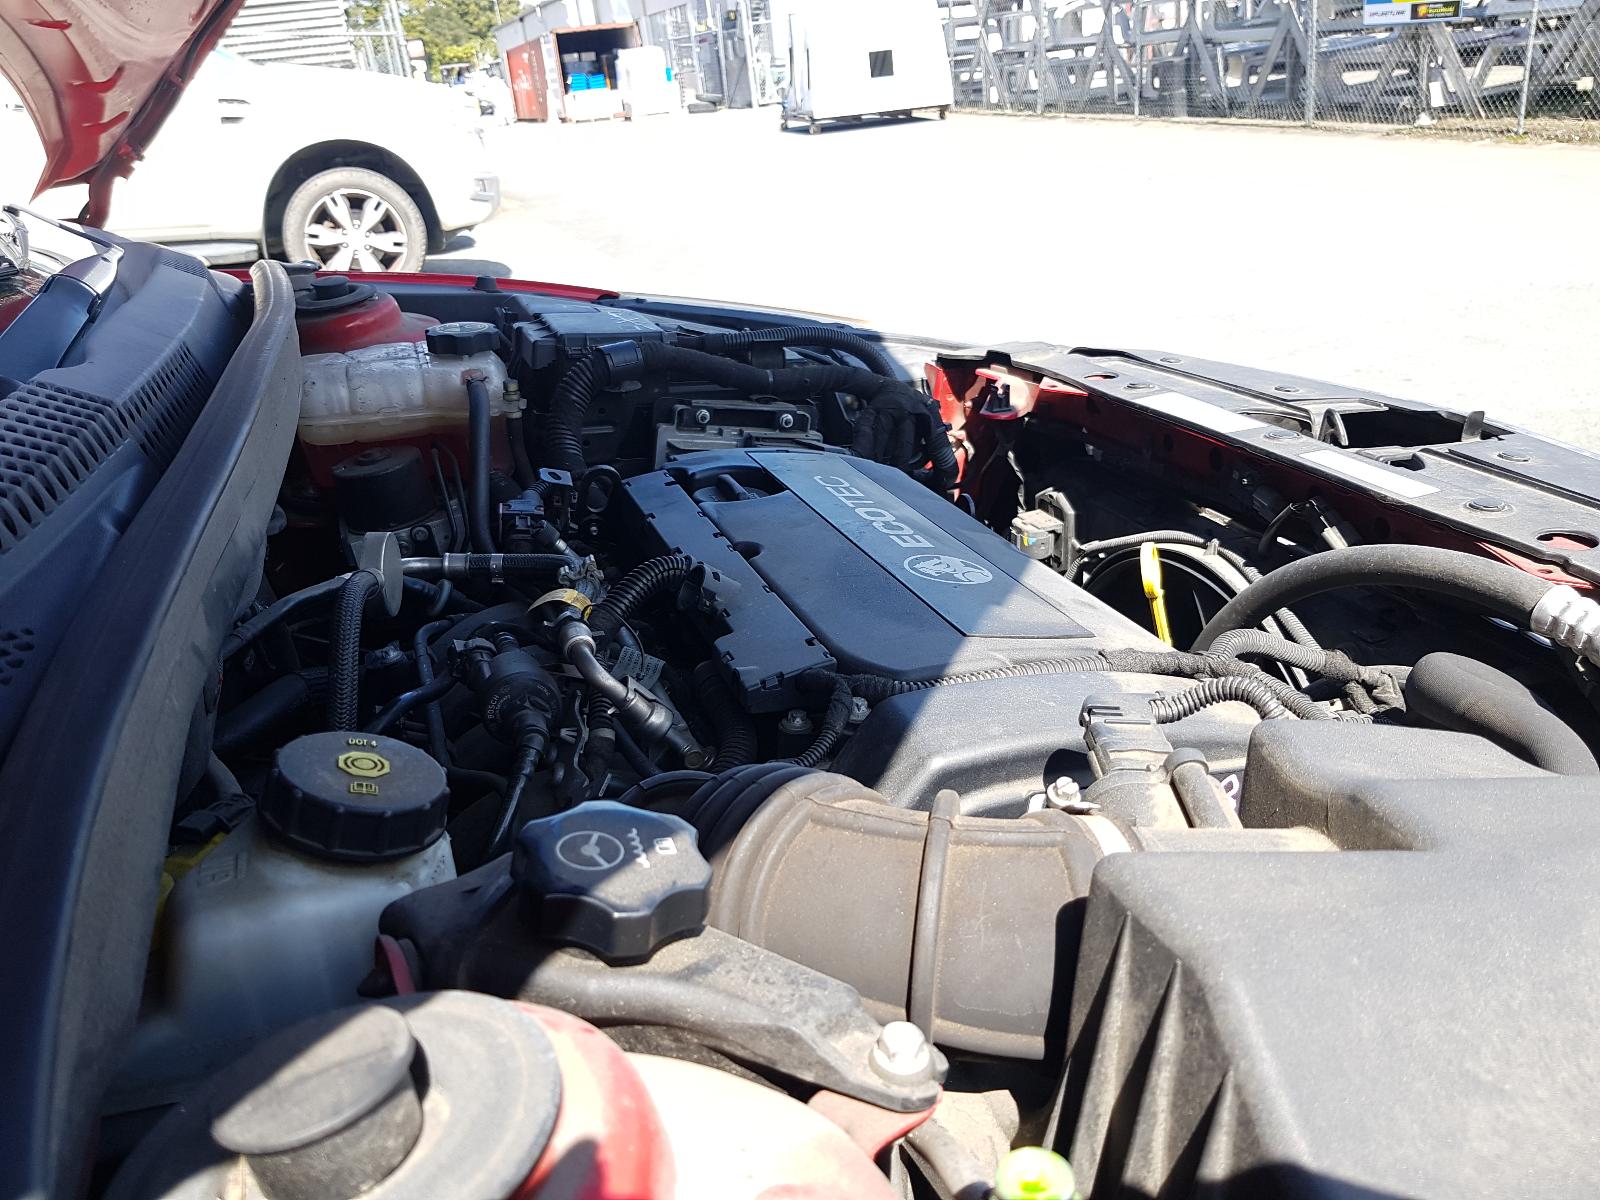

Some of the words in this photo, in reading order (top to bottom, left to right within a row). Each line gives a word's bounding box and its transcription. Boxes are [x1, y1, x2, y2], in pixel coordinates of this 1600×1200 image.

[813, 475, 936, 548] ECOTEC
[347, 737, 368, 747] DOT
[370, 738, 378, 747] 4
